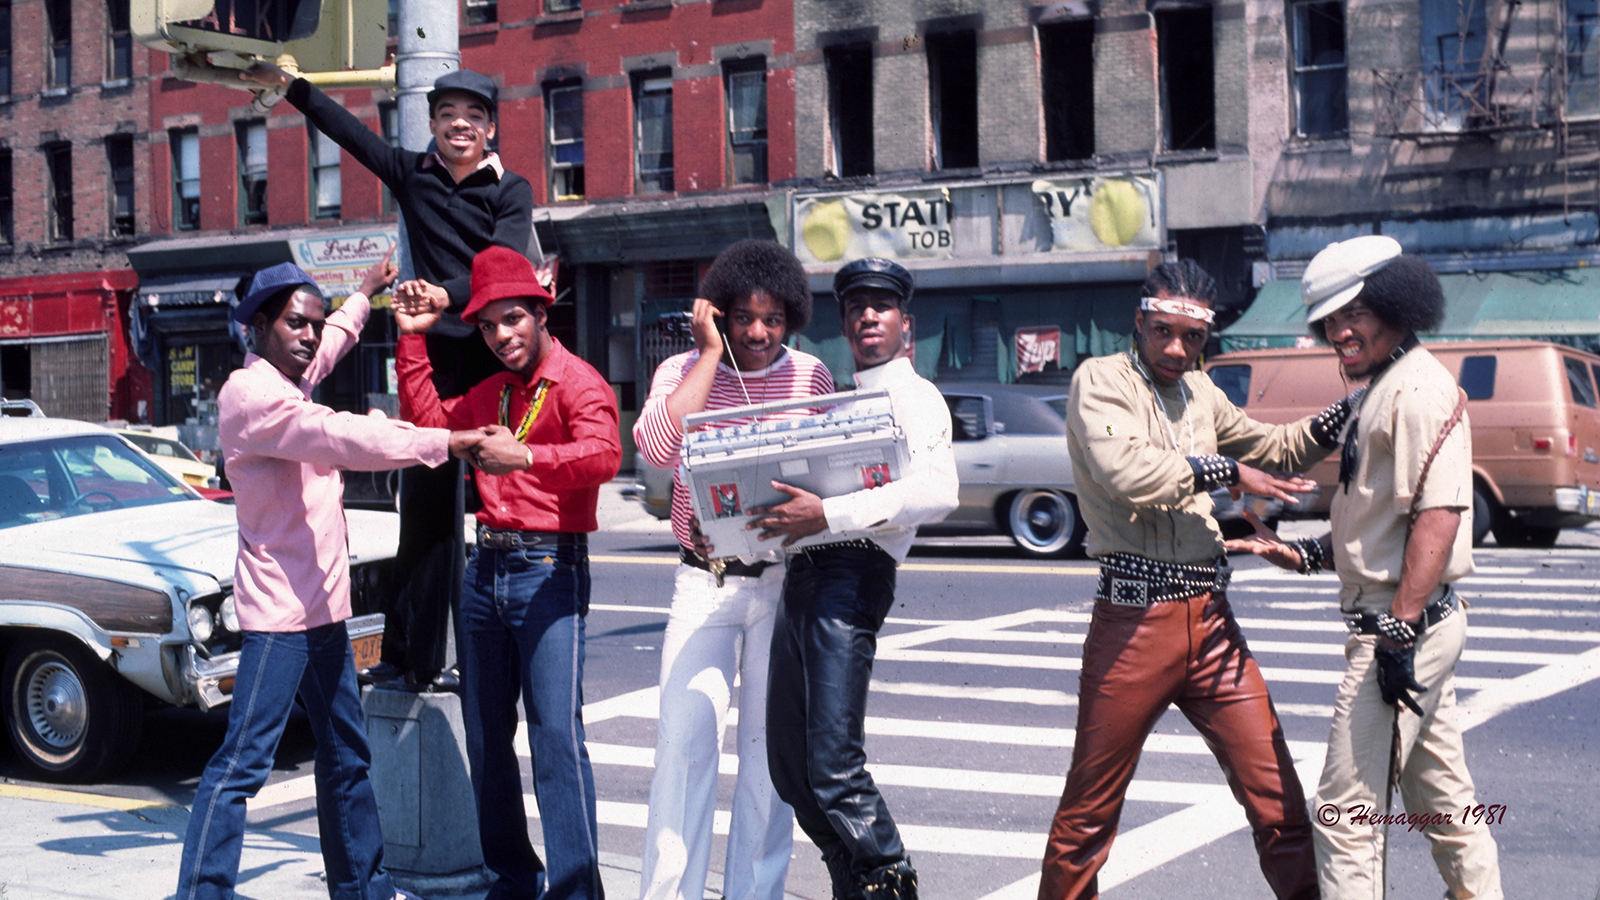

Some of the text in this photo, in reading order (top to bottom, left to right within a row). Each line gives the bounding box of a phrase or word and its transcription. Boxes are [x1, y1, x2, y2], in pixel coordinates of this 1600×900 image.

[176, 0, 273, 39] ALK
[908, 230, 951, 249] TOB
[170, 373, 195, 386] STORE
